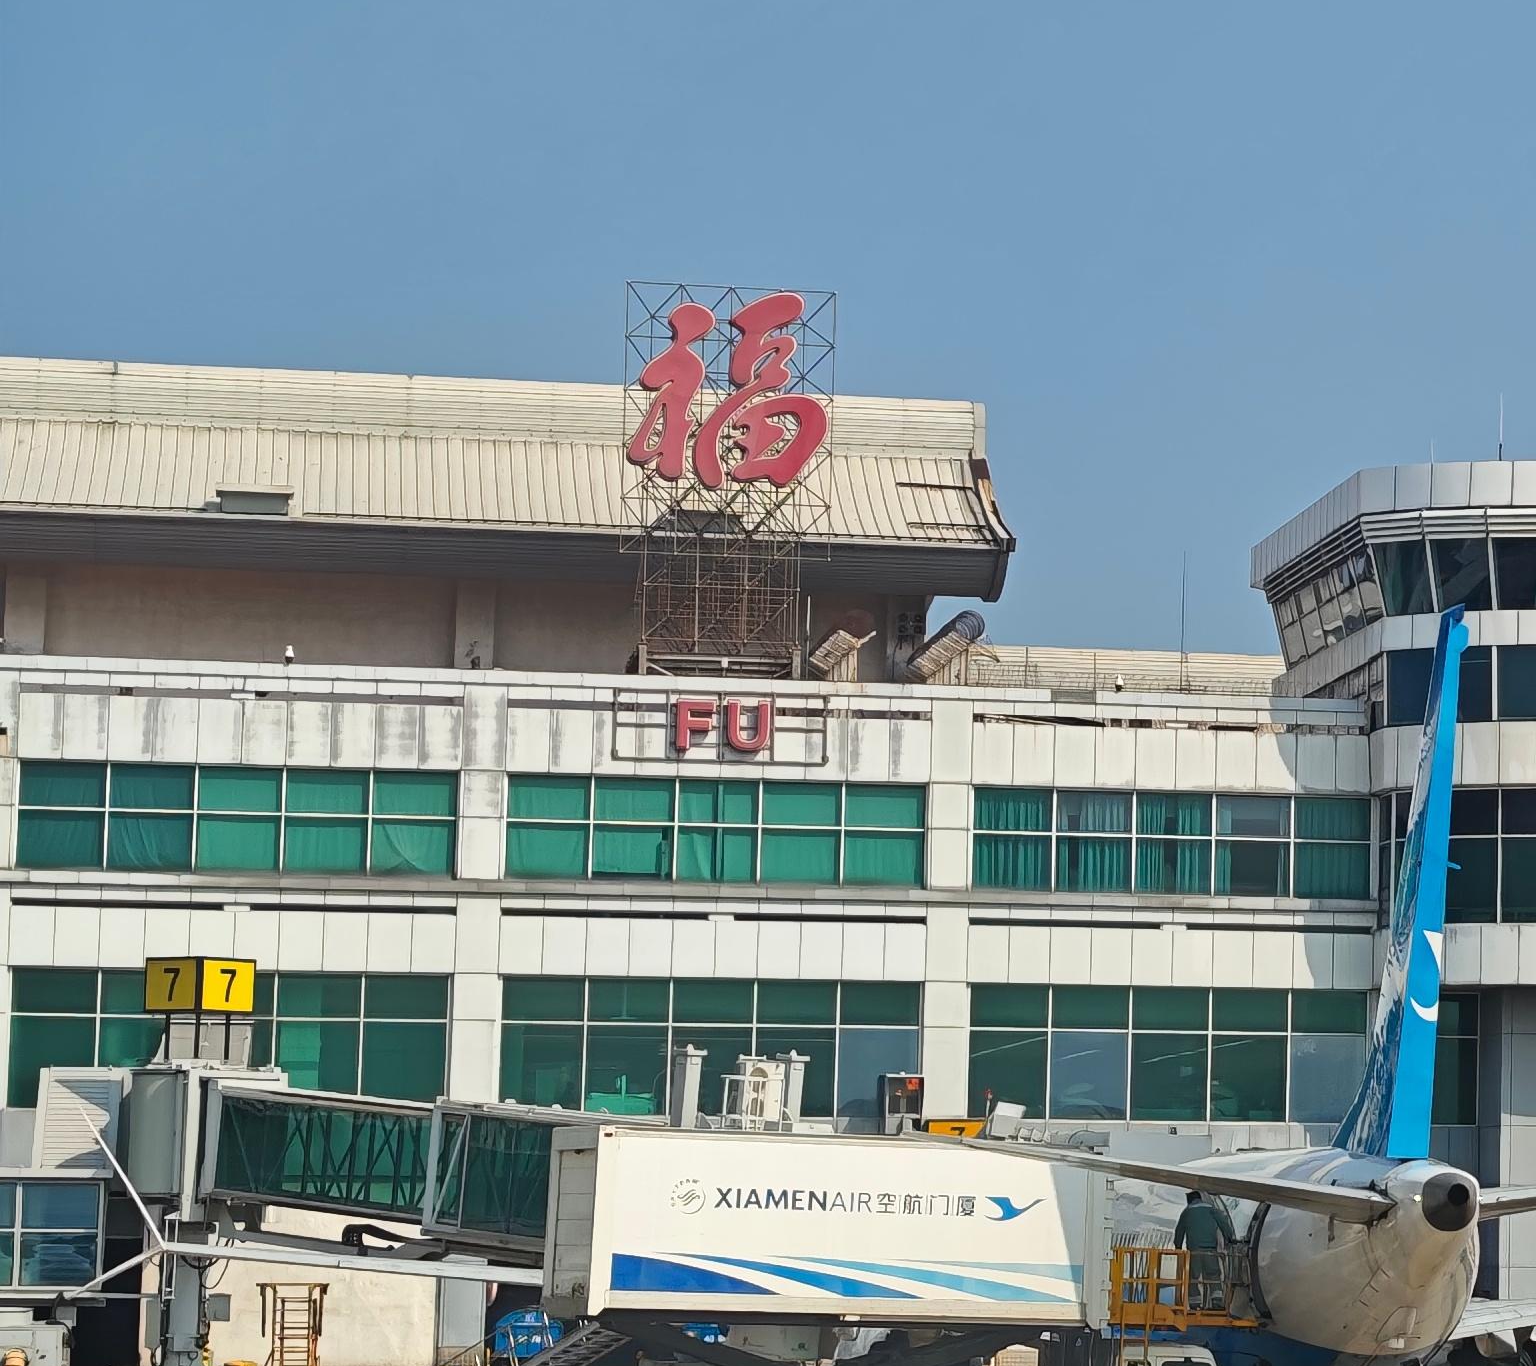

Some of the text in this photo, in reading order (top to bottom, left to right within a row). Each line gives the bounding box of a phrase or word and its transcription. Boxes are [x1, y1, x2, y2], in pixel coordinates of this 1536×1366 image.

[626, 291, 829, 489] 福
[674, 698, 771, 752] FU
[163, 967, 181, 1002] 7
[220, 968, 237, 1003] 7
[714, 1187, 872, 1213] XIAMENAIR
